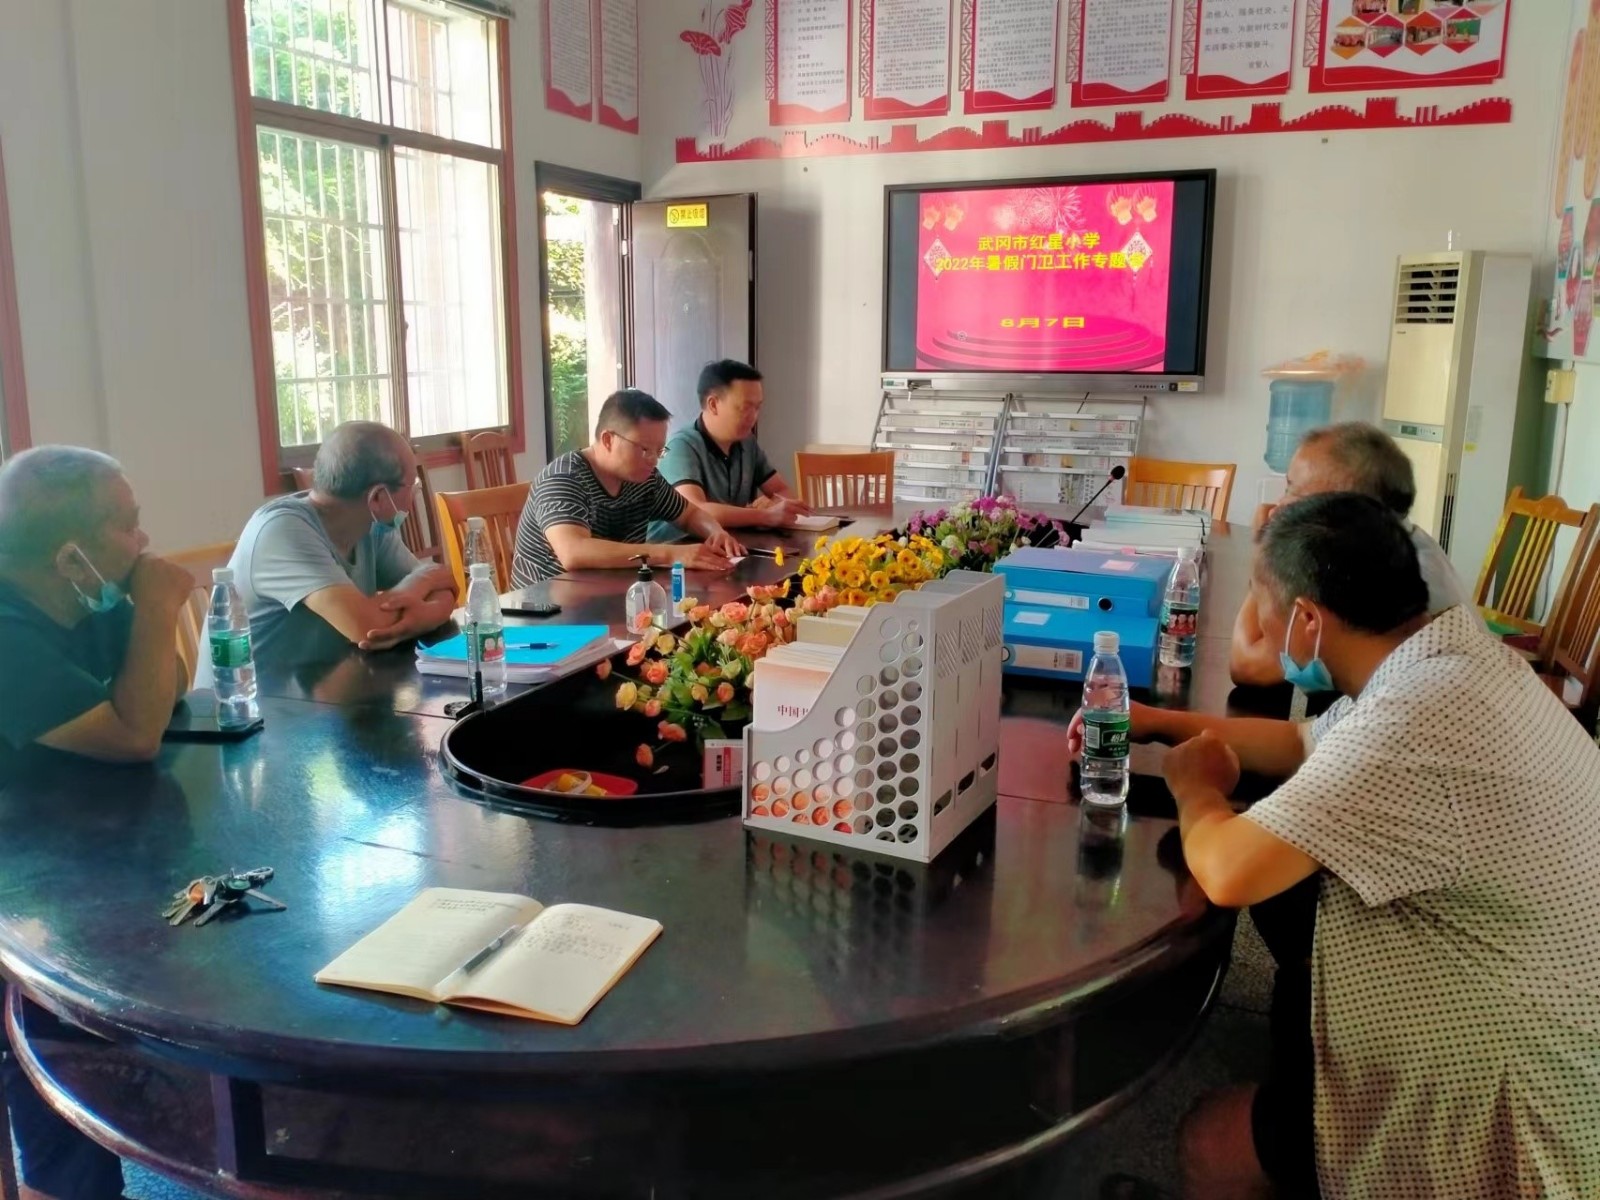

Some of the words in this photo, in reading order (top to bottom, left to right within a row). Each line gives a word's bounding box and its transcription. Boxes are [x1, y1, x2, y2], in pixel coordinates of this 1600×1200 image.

[977, 232, 1100, 251] 武冈市红星小学
[1000, 317, 1085, 328] 8月7日
